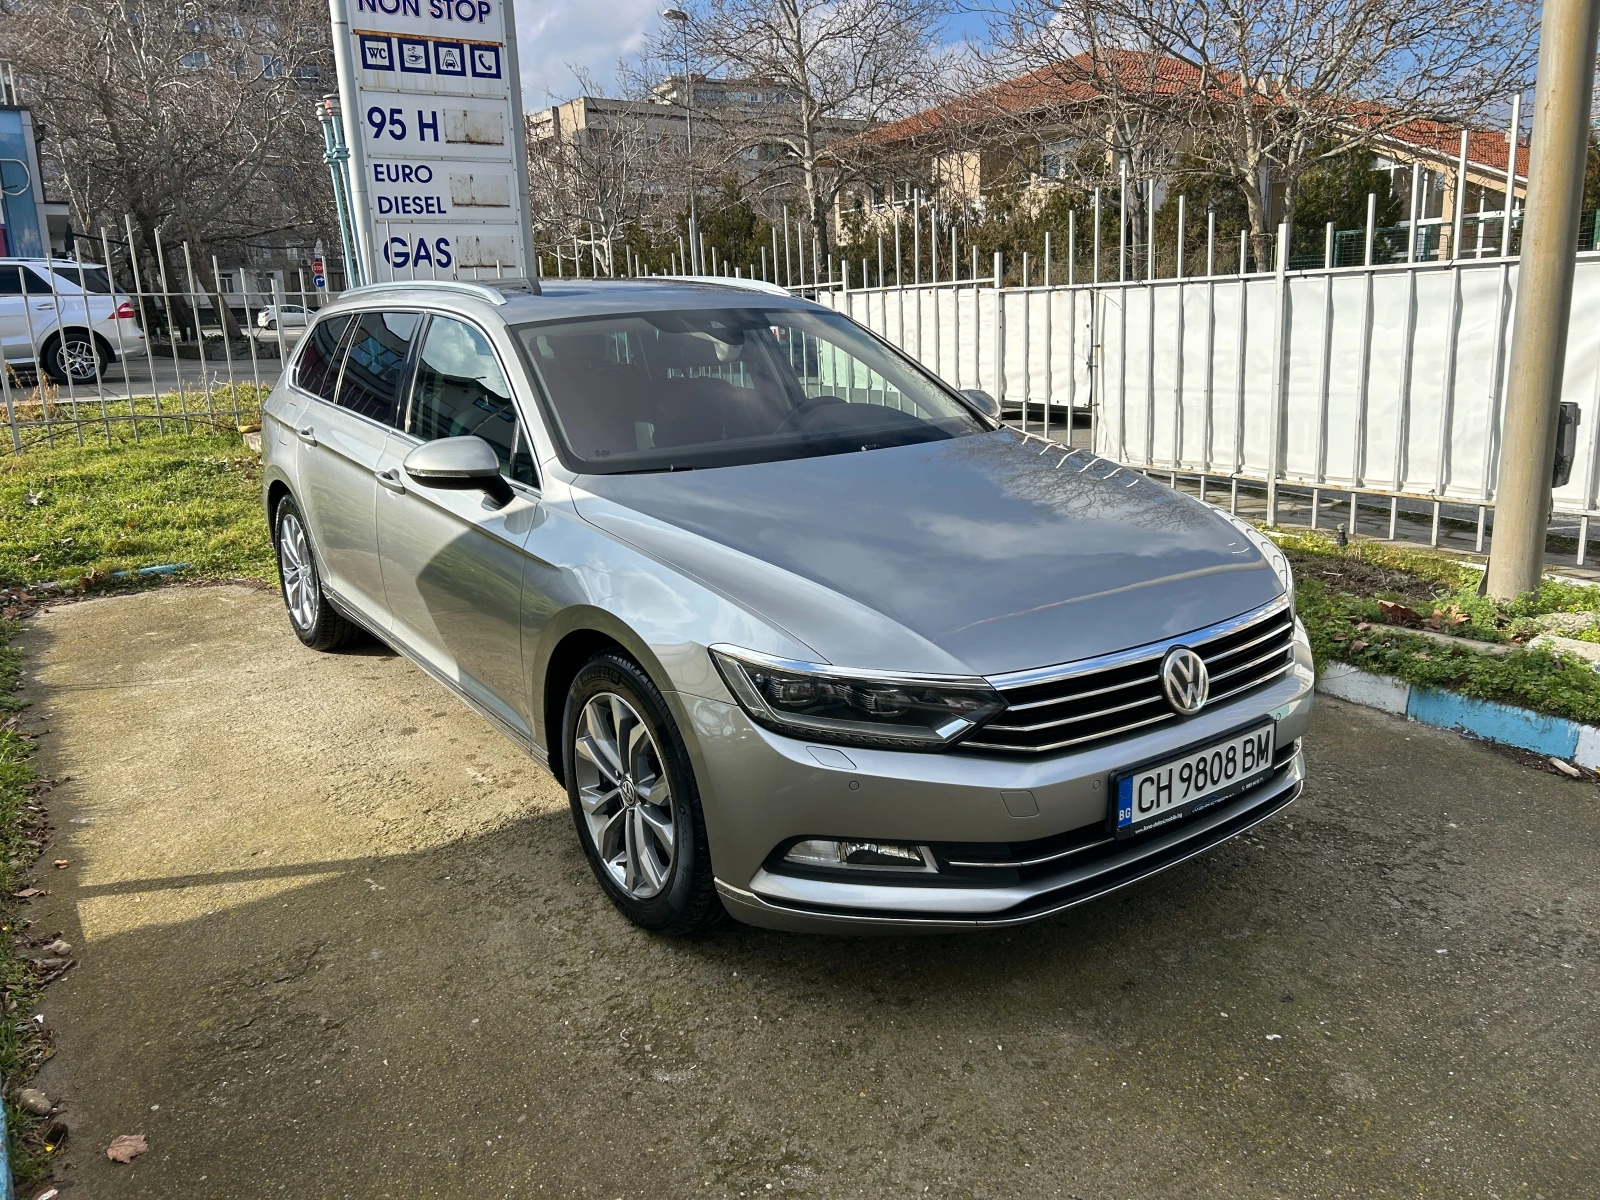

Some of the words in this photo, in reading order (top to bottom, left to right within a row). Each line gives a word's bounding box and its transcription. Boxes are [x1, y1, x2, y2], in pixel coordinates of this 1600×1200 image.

[357, 0, 420, 17] NON
[429, 0, 492, 24] STOP
[366, 46, 388, 60] WC
[366, 106, 407, 140] 95
[417, 109, 440, 142] H
[373, 163, 433, 183] EURO
[378, 195, 447, 215] DIESEL
[383, 236, 452, 269] GAS
[1137, 767, 1172, 814] CH
[1178, 743, 1237, 799] 9808
[1241, 729, 1272, 774] BM
[1118, 807, 1131, 820] BG
